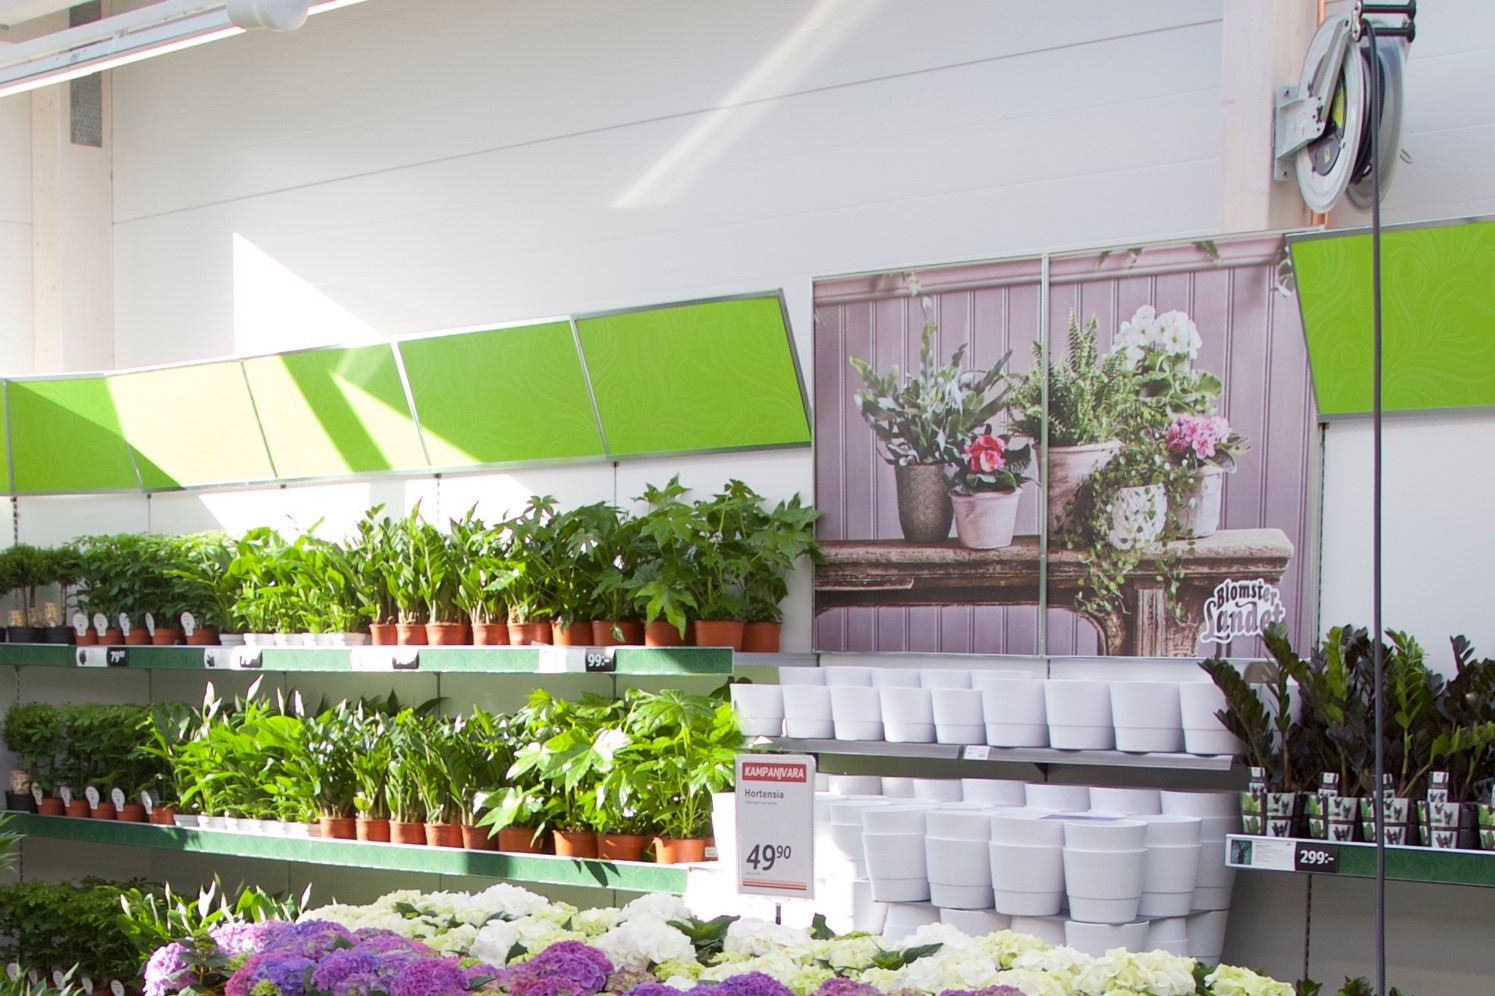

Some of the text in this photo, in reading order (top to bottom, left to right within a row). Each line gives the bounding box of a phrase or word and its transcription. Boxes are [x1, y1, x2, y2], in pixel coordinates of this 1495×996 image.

[1216, 582, 1278, 610] Blomster
[1202, 601, 1284, 640] Landet
[744, 766, 805, 780] KAMPANJVARA
[744, 789, 784, 799] Hortensia
[1300, 850, 1334, 864] 299:-
